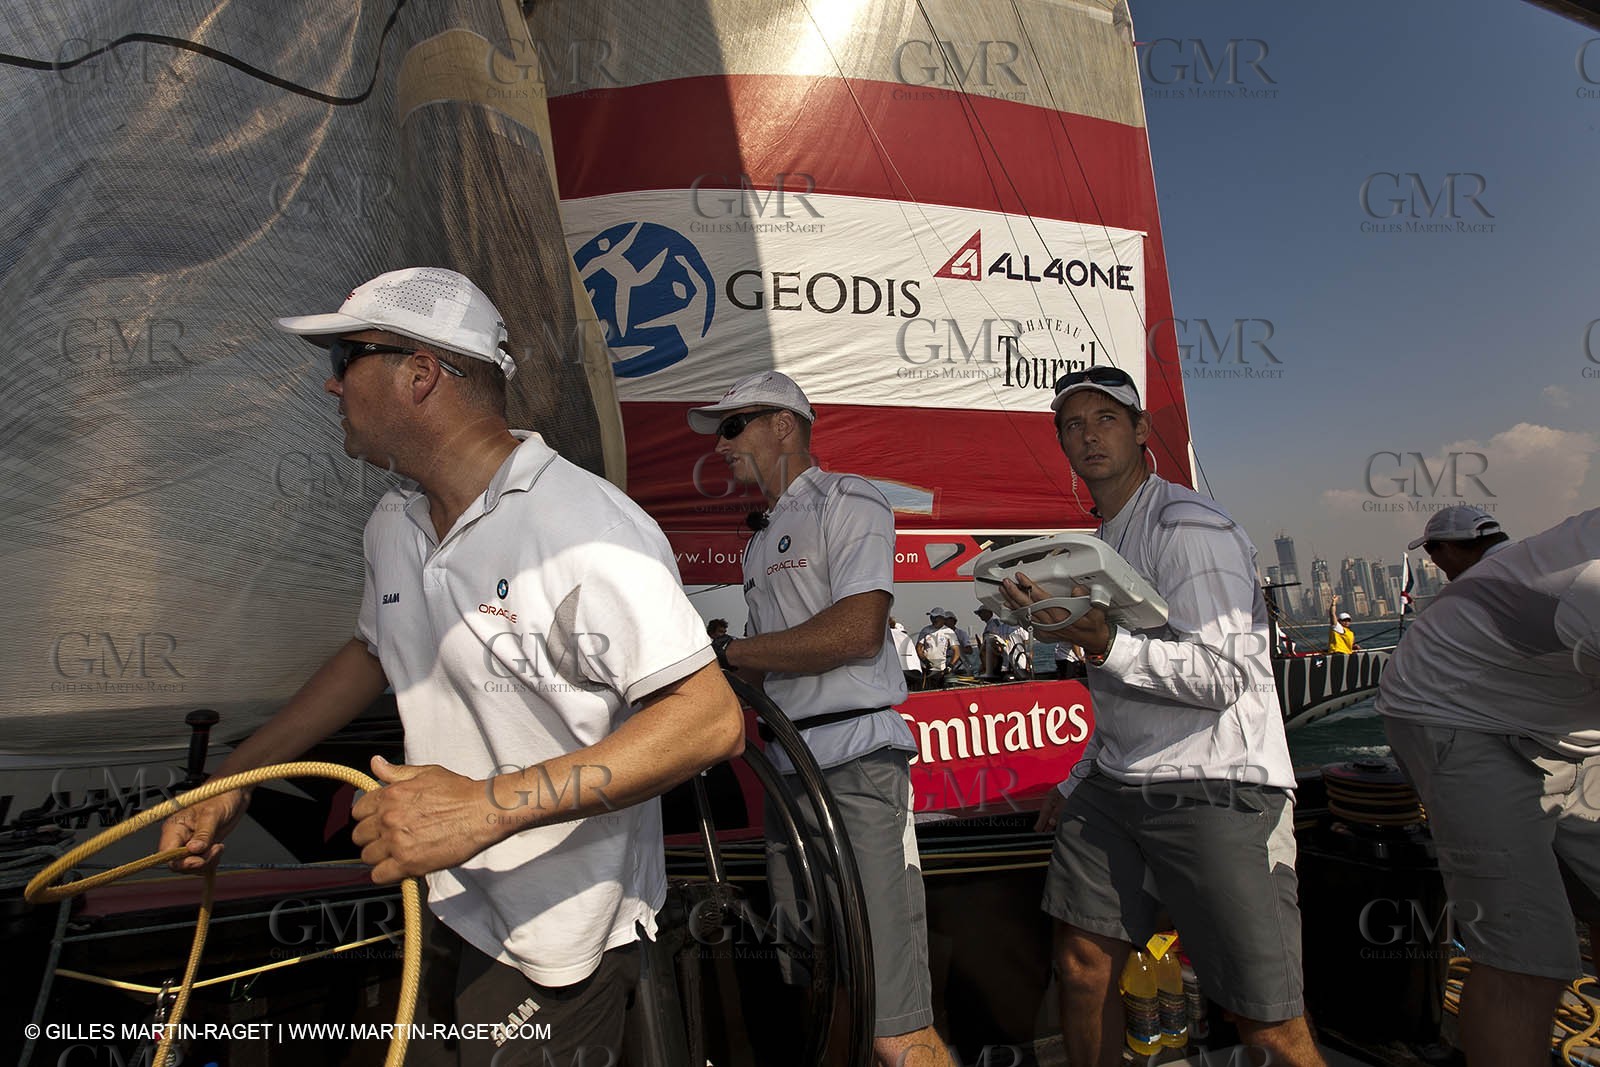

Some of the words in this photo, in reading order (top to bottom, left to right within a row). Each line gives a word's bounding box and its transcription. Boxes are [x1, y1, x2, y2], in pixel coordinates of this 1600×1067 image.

[725, 269, 921, 318] GEODIS
[1017, 318, 1082, 339] CHATEAU
[766, 558, 808, 575] ORACLE
